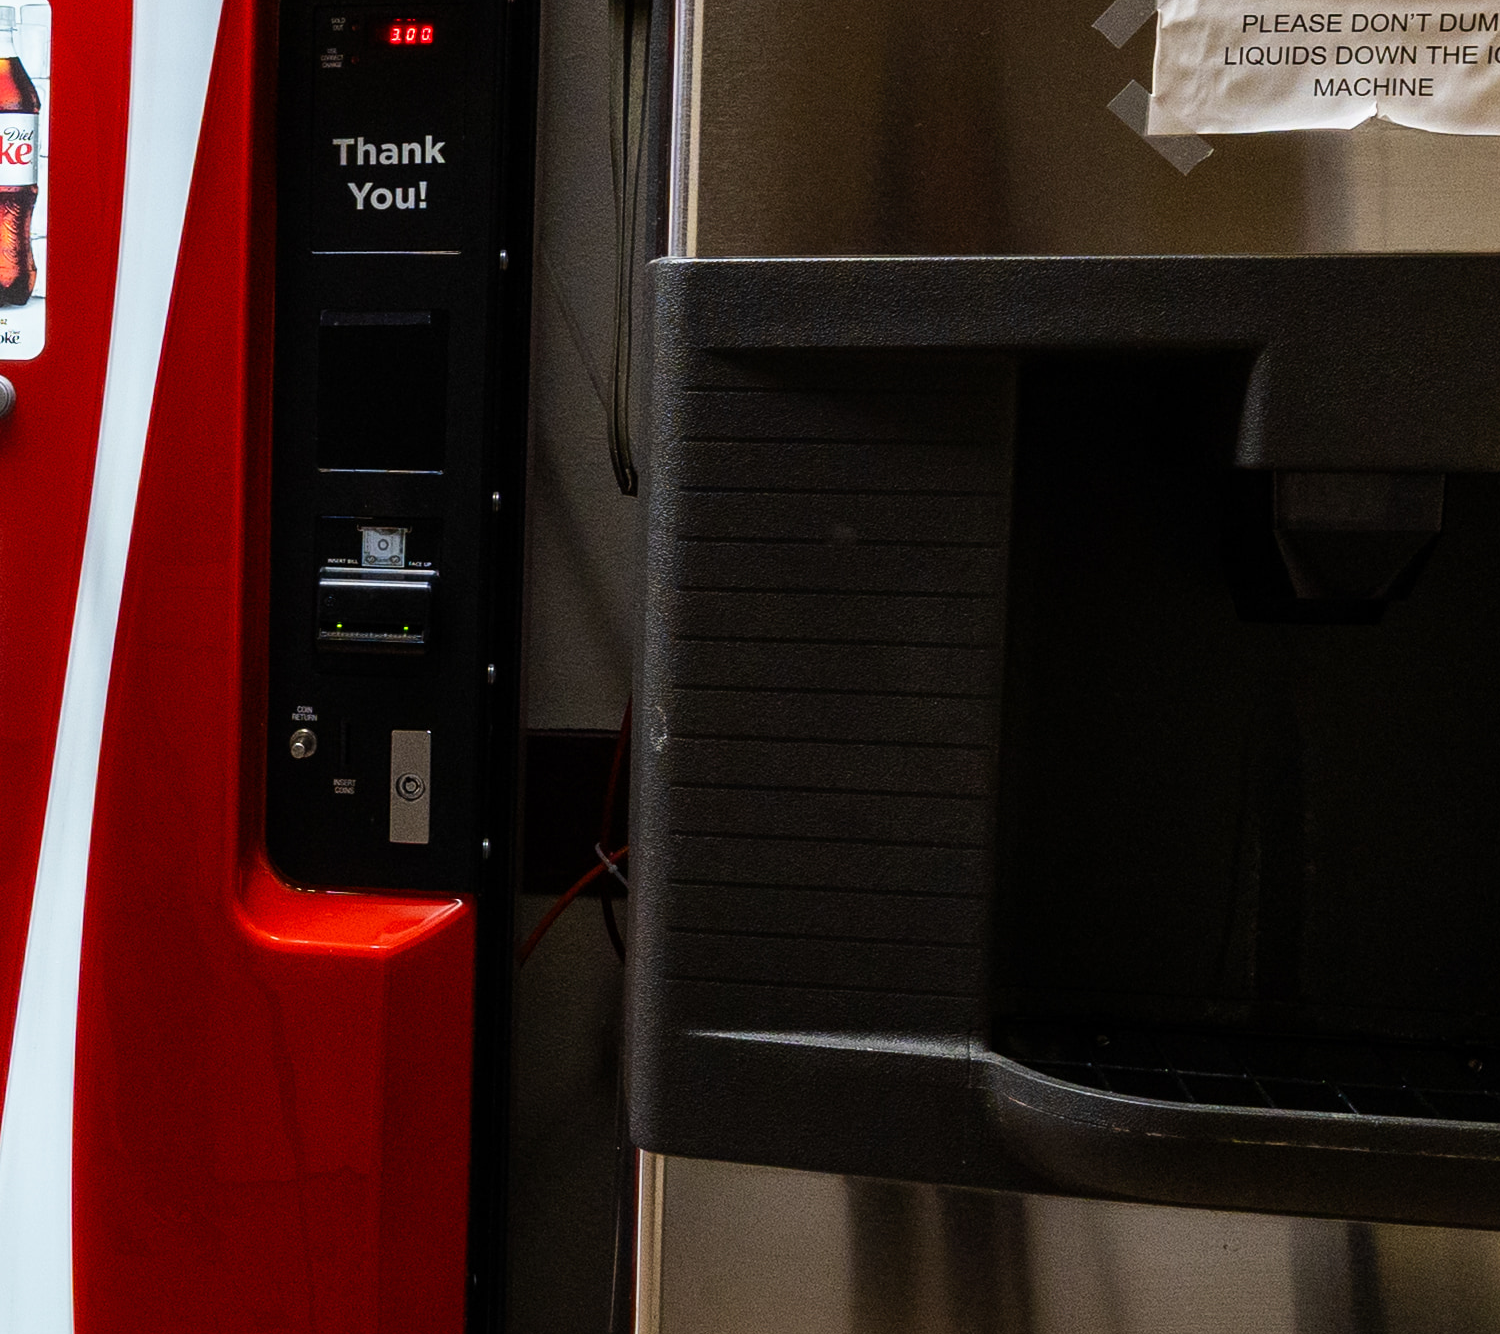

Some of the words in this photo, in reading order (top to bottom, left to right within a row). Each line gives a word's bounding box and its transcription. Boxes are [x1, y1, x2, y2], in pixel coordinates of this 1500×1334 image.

[1242, 13, 1343, 34] PLEASE
[1351, 13, 1433, 33] DON'T
[1224, 45, 1328, 67] LIQUIDS
[1335, 45, 1418, 65] DOWN
[1426, 45, 1479, 65] THE
[1313, 77, 1434, 97] MACHINE
[3, 127, 34, 142] Diet
[332, 135, 446, 165] Thank
[347, 181, 428, 210] You!
[291, 713, 318, 722] RETURN
[333, 779, 356, 787] INSERT
